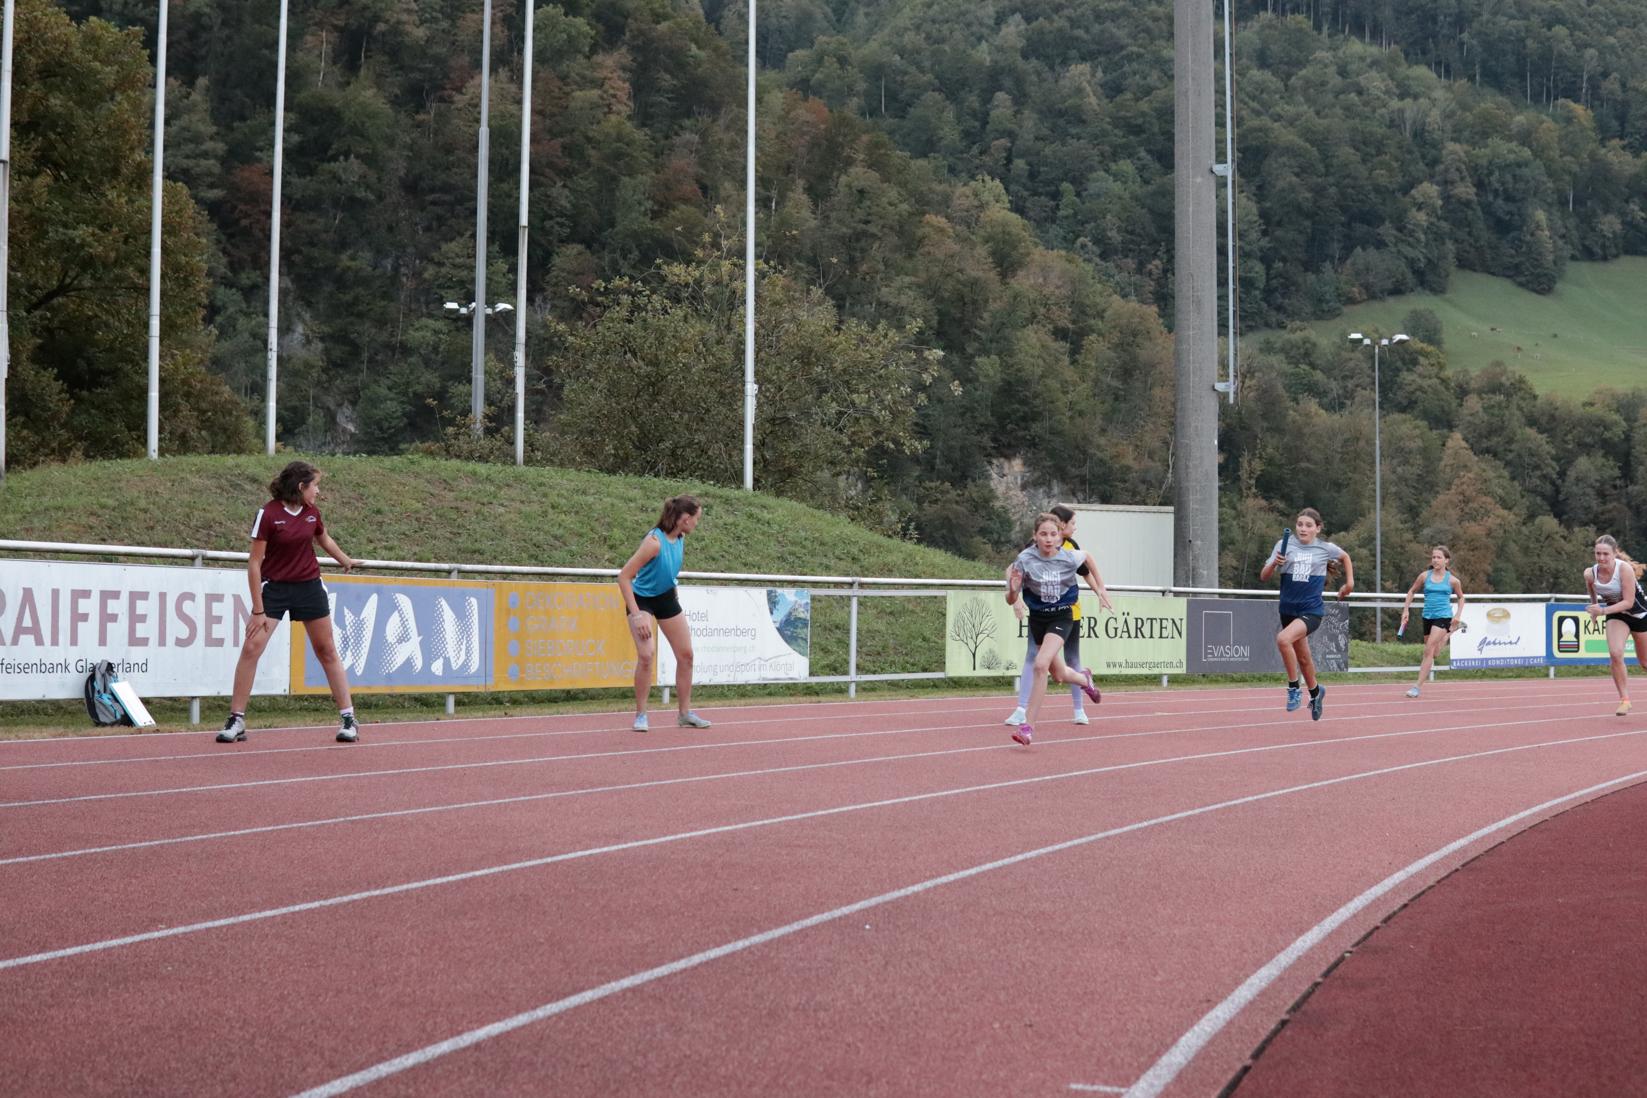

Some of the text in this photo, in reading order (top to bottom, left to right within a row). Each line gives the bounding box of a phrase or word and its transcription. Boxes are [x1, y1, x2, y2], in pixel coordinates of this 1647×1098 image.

[0, 587, 251, 648] AIFFEISEN
[684, 609, 709, 622] Hotel
[688, 625, 756, 640] hodannenberg
[1017, 612, 1184, 639] HER GÄRTEN
[75, 658, 148, 674] Glaerland
[1106, 659, 1184, 670] www.hausergaerten.ch
